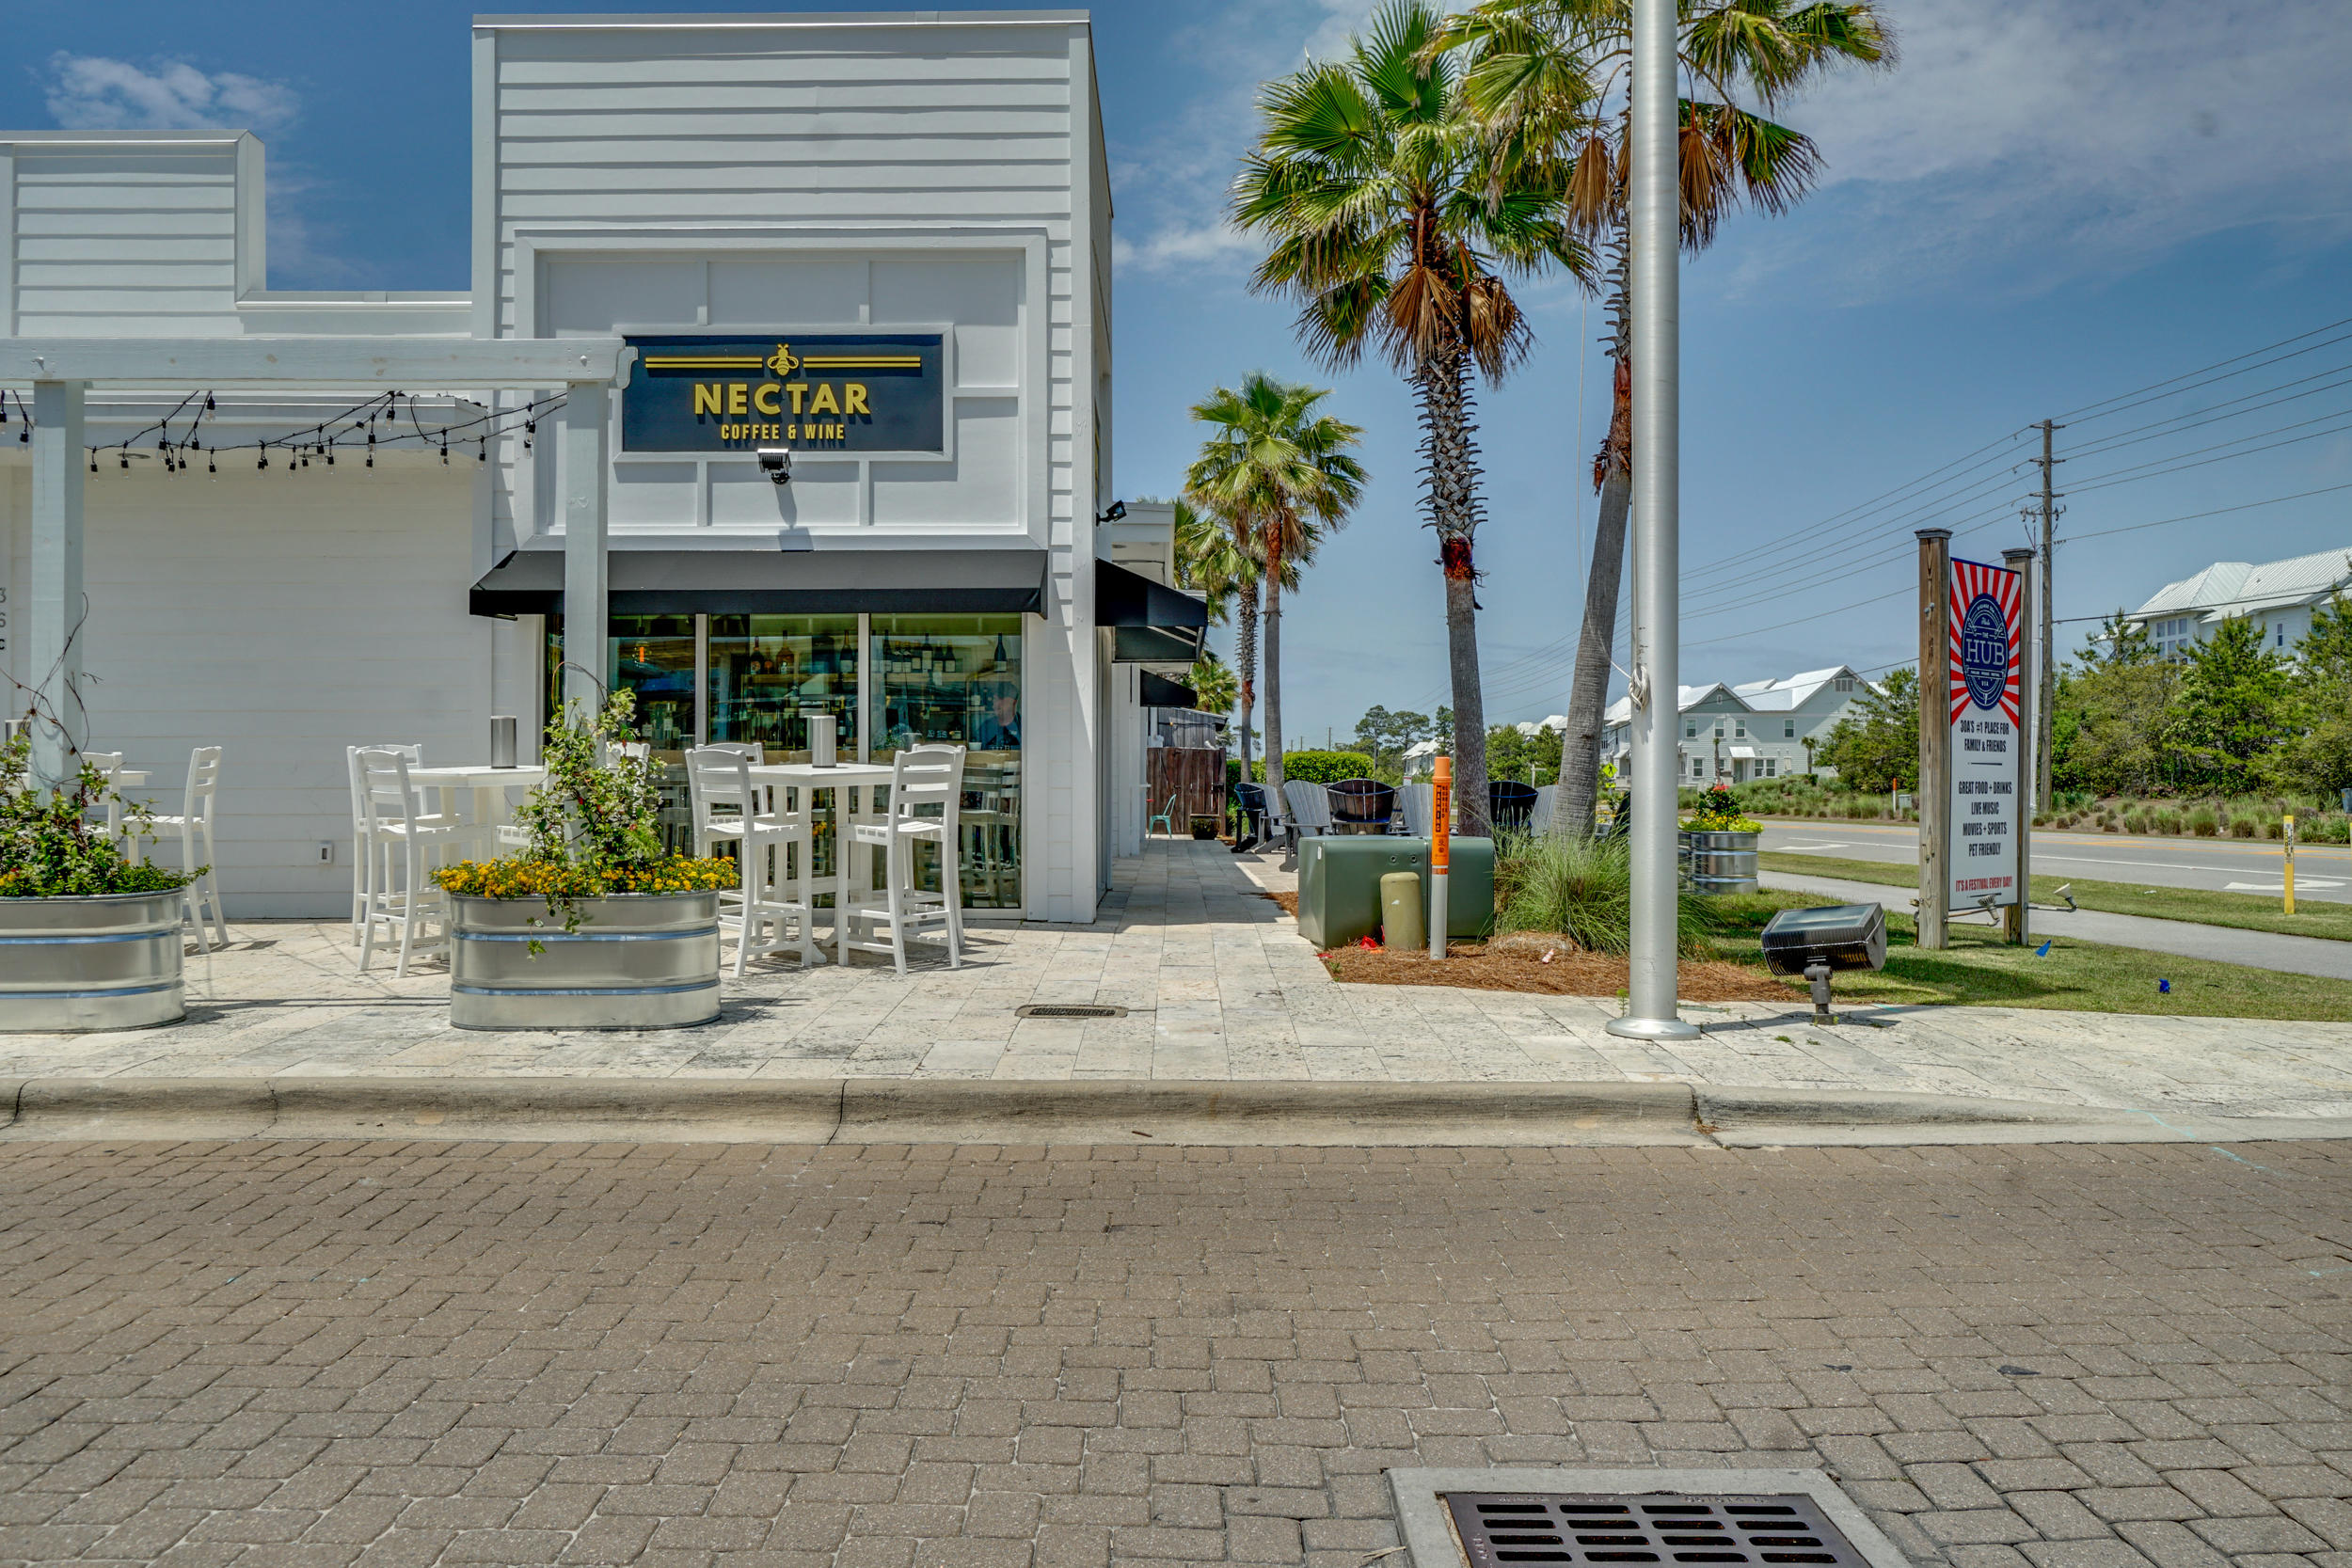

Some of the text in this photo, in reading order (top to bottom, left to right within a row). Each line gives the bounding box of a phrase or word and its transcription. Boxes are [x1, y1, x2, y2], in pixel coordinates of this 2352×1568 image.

[694, 383, 871, 415] NECTAR
[721, 423, 845, 440] COFFEE & WINE
[1965, 639, 2005, 665] HUB
[1960, 720, 2010, 736] 30A'S #1 PLACE FOR
[1964, 738, 1981, 752] FAMILY
[1986, 739, 2007, 752] FRIENDS
[1959, 782, 1974, 794] GREAT
[1975, 782, 1989, 794] FOOD
[1994, 782, 2012, 794] DRINKS
[1971, 801, 1999, 815] LIVE MUSIC
[1963, 823, 1982, 836] MOVIES
[1987, 822, 2007, 835] SPORTS
[1968, 843, 2001, 857] PET FRIENDLY
[1956, 879, 1964, 892] IT'S
[1968, 878, 1989, 891] FESTIVAL
[1989, 877, 2002, 889] EVERY
[2003, 877, 2012, 888] DAY!
